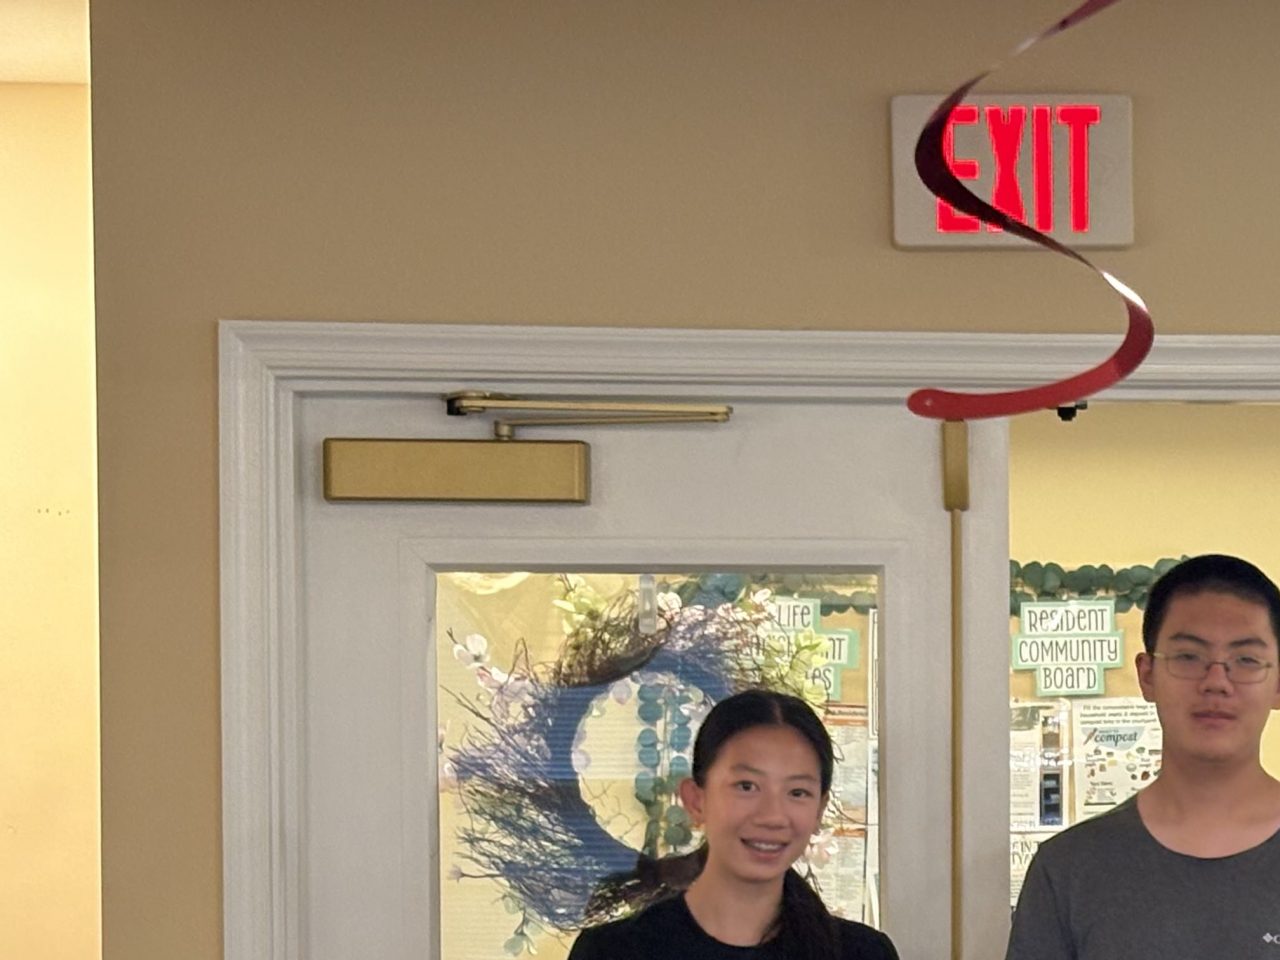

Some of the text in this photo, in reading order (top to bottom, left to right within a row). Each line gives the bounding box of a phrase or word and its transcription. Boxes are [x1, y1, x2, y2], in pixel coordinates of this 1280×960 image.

[937, 105, 1101, 232] EXIT
[778, 605, 811, 628] LIFE
[1027, 608, 1108, 632] RESIDENT
[1019, 639, 1118, 663] COMMUNITY
[1043, 667, 1097, 690] BOARD
